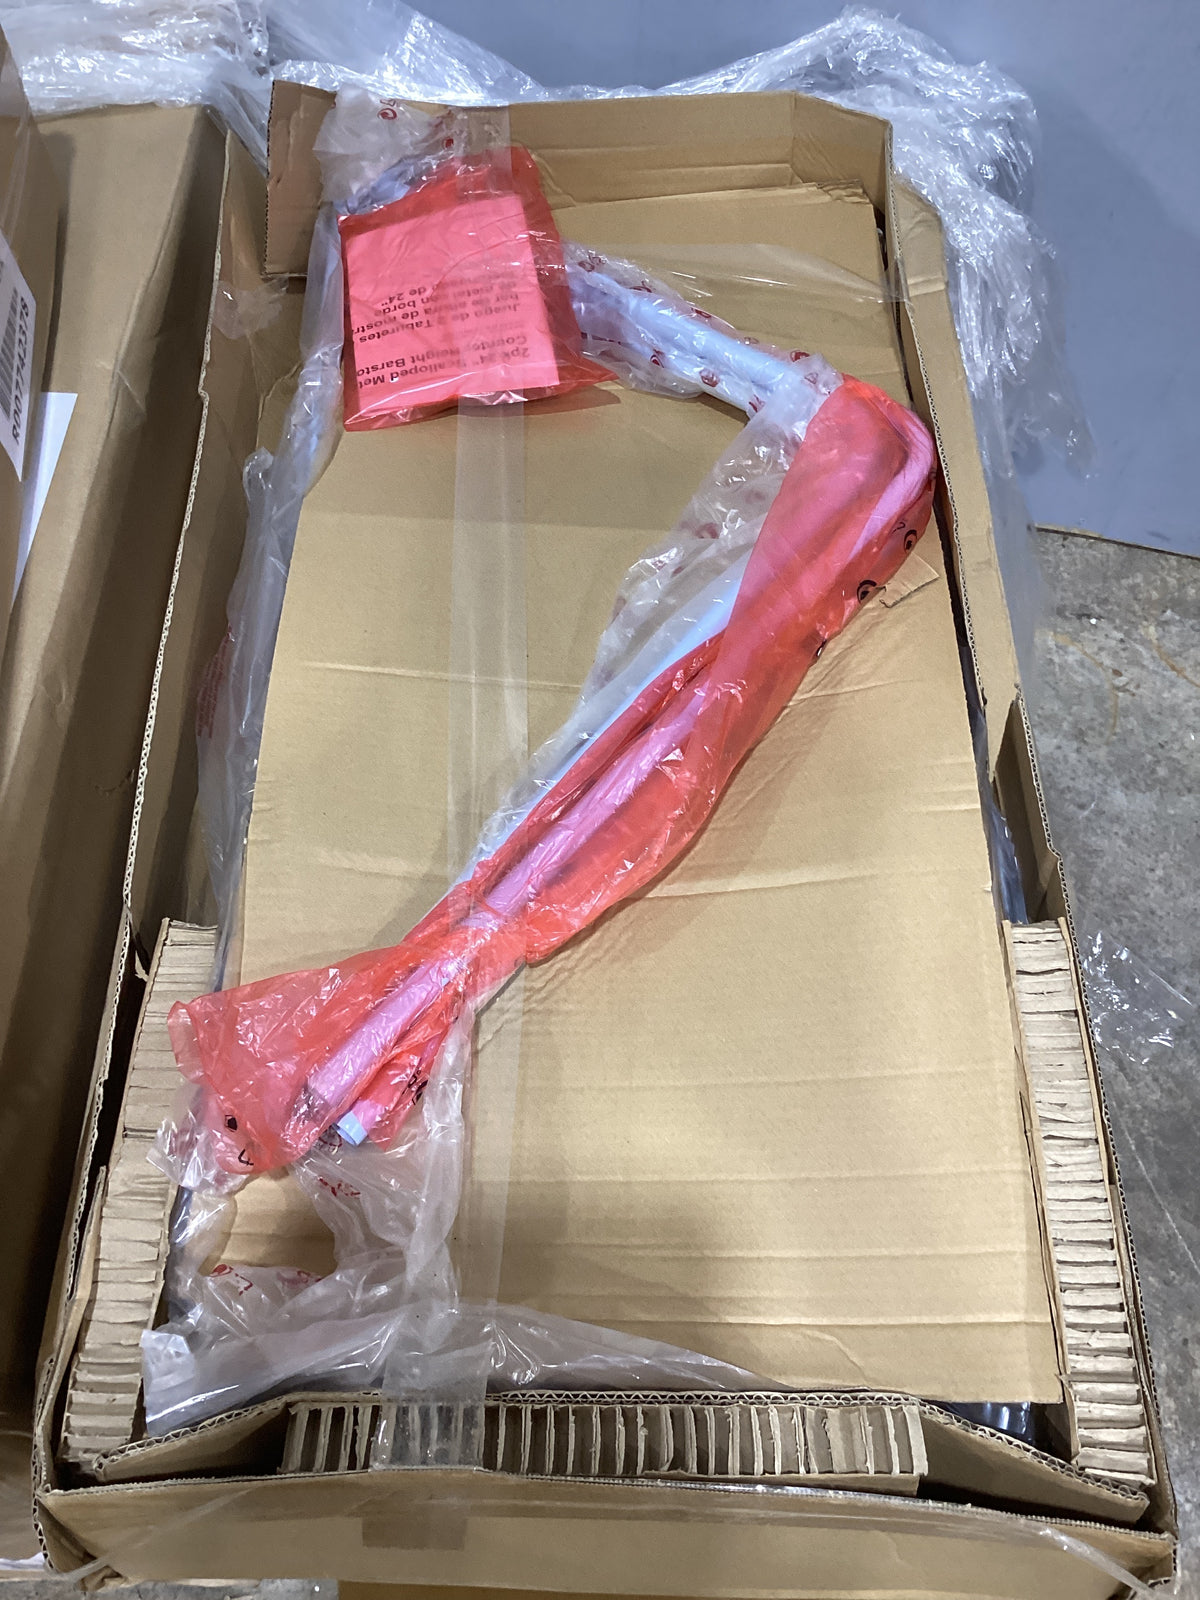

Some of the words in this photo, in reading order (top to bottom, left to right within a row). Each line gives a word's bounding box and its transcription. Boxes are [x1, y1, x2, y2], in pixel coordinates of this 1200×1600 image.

[408, 286, 427, 295] de
[381, 293, 404, 307] 24"
[374, 300, 416, 317] borde
[401, 310, 419, 320] de
[359, 319, 432, 342] Taburetes
[466, 335, 527, 351] Counte
[12, 297, 29, 445] R007742378
